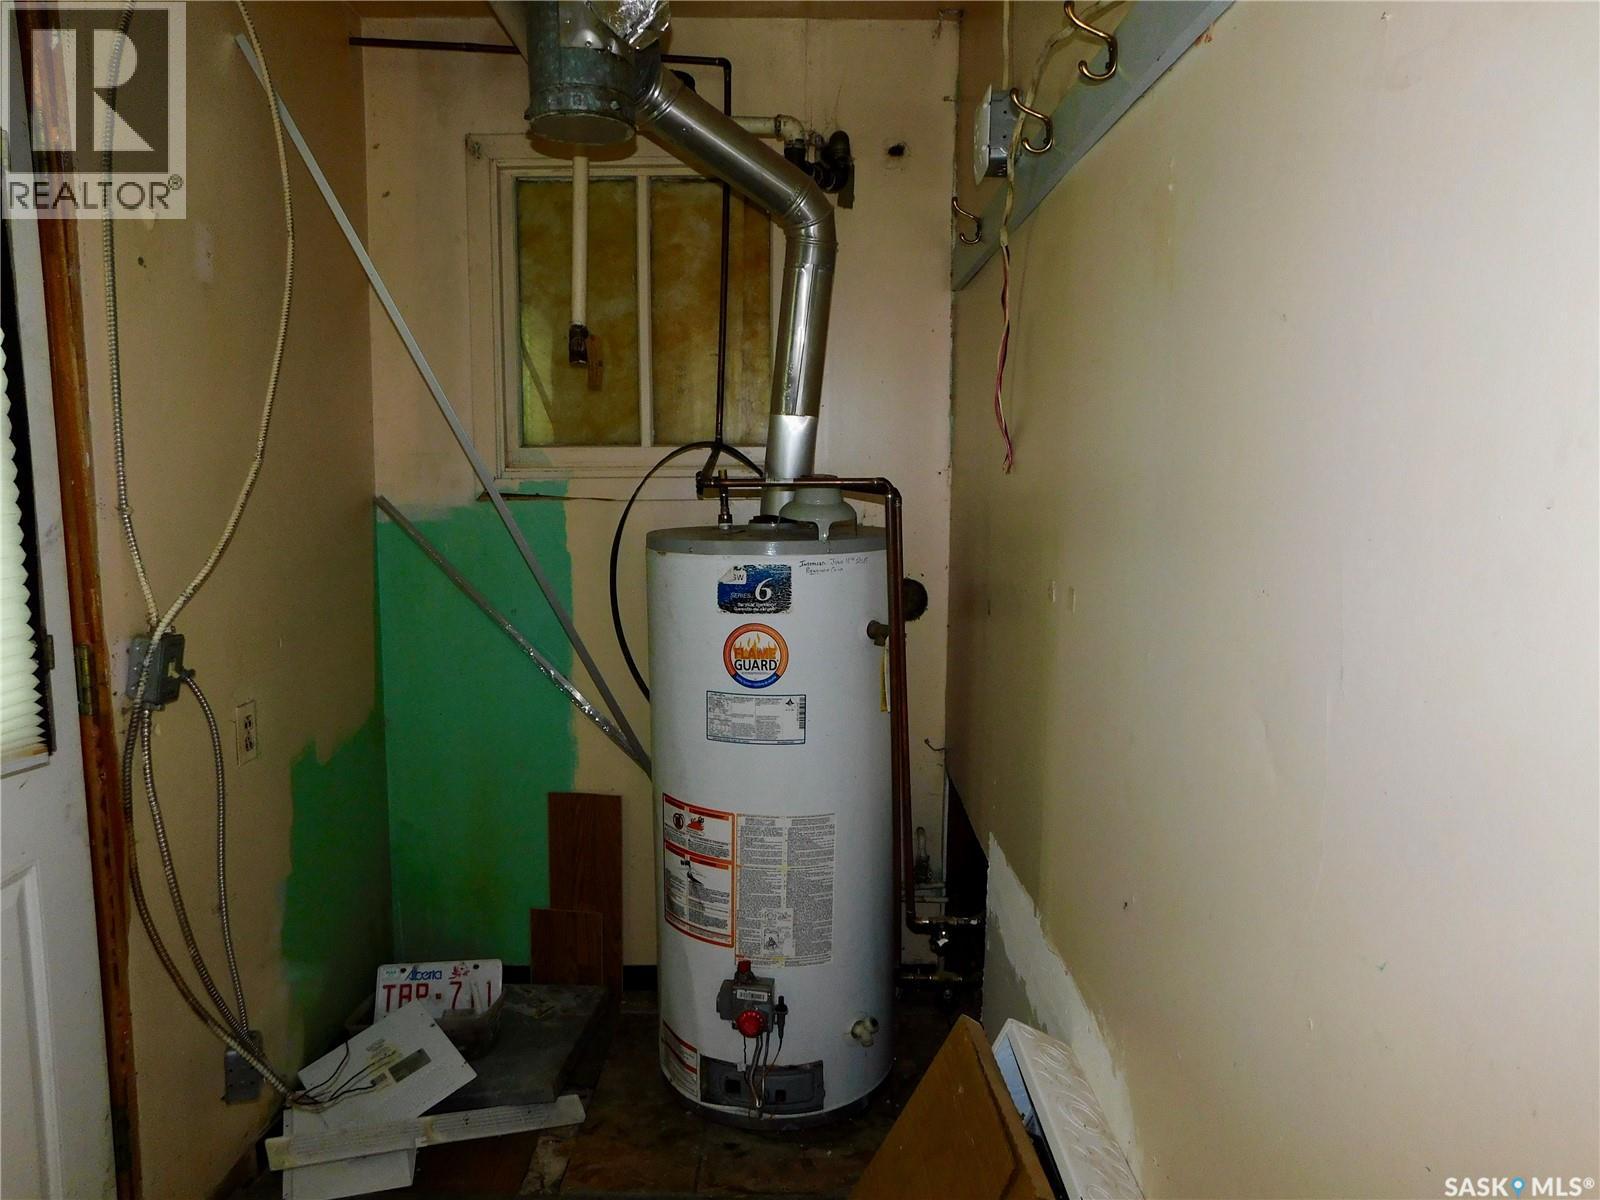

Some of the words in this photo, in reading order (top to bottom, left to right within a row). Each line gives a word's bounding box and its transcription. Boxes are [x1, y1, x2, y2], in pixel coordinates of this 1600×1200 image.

[755, 577, 774, 601] 6
[733, 646, 777, 659] FLAME
[734, 659, 778, 671] GUARD
